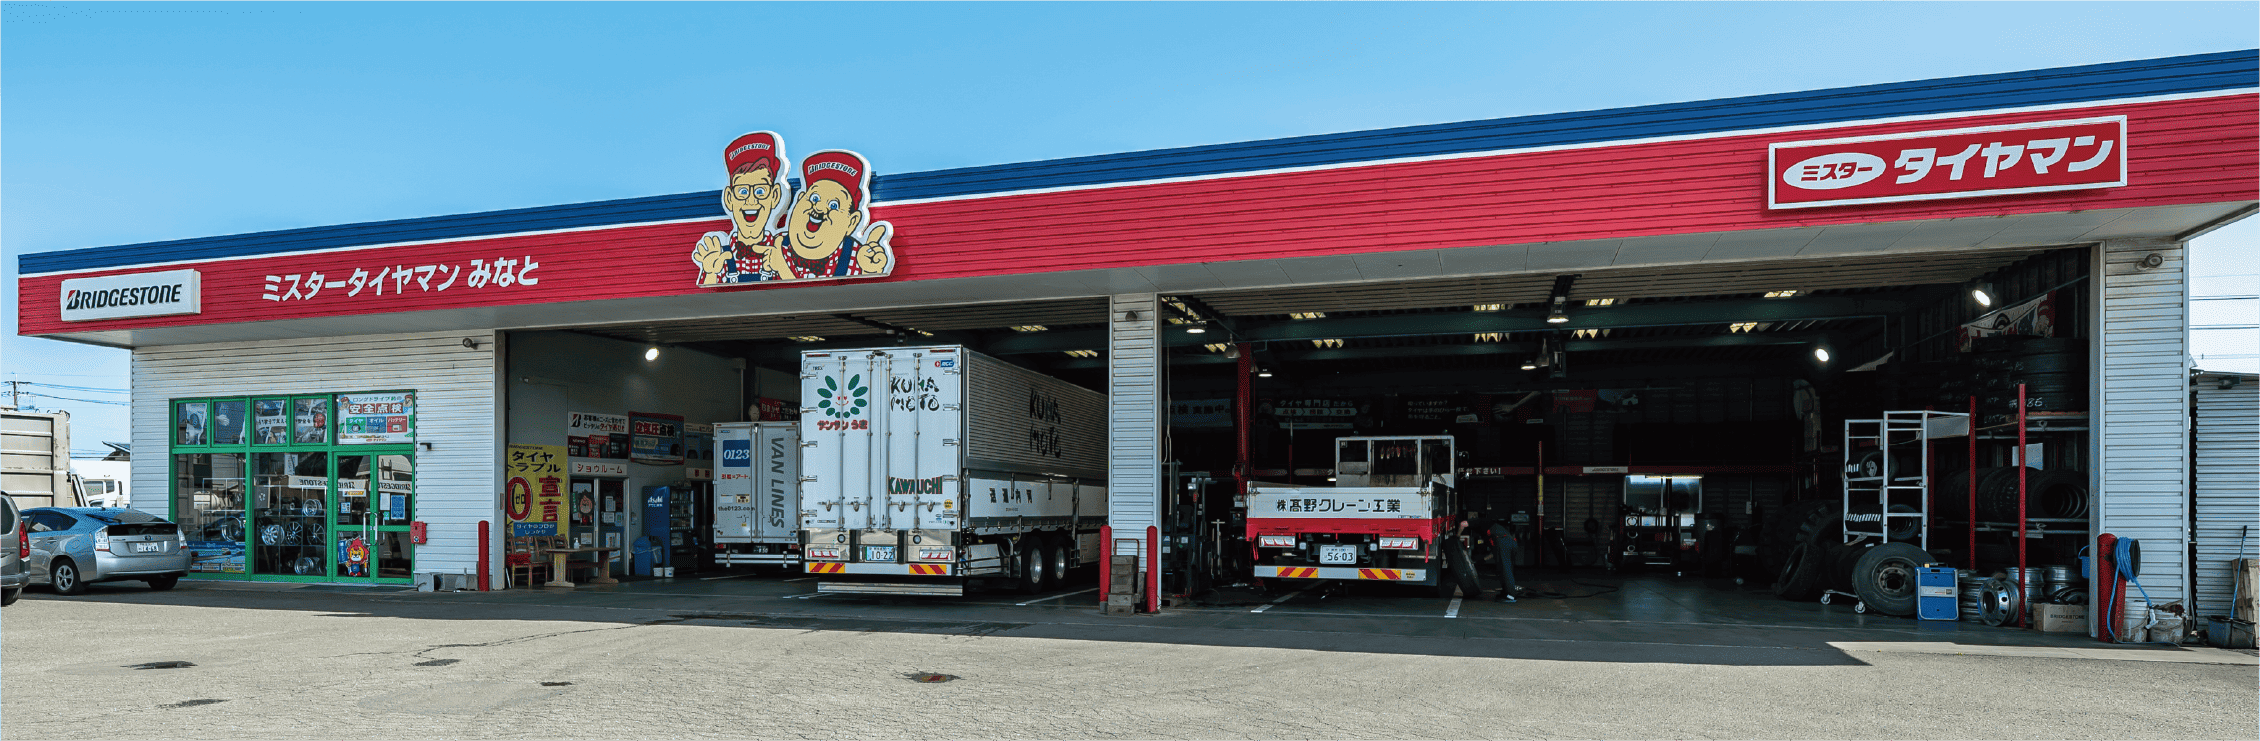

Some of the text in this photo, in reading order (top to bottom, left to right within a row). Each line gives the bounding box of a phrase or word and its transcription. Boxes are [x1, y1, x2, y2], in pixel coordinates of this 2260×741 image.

[729, 143, 771, 160] BRIDGESTONE
[1801, 135, 2114, 184] ミスター タイヤマン
[808, 162, 858, 177] BRIDGESTONE
[262, 255, 539, 302] ミスタータイヤマン みなと
[66, 284, 182, 310] BRIDGESTONE
[349, 403, 403, 414] 安全点検
[1162, 404, 1188, 415] 点検
[512, 451, 554, 462] タイヤ
[723, 449, 750, 460] 0123
[578, 463, 623, 473] ショウルーム
[771, 437, 784, 528] VAN LINES
[888, 476, 943, 495] KAWAUCHI
[539, 475, 562, 522] 宣言
